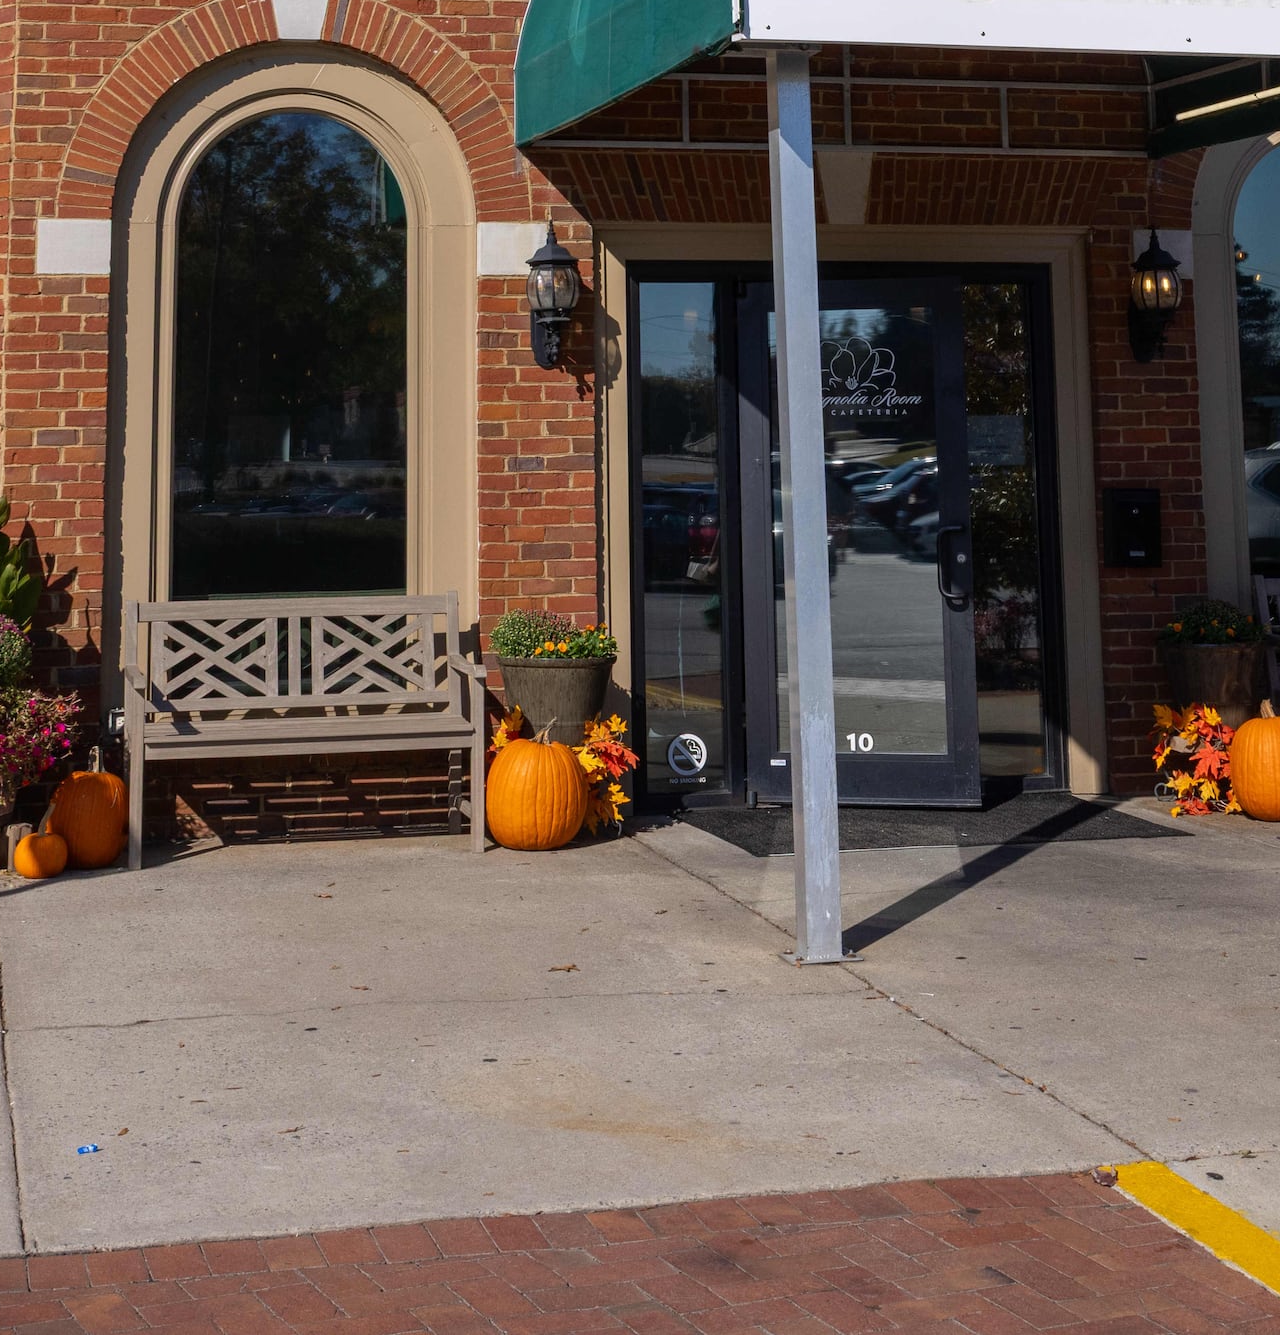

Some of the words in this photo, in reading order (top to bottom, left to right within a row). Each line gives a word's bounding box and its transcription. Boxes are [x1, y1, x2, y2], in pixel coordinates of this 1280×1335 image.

[870, 387, 922, 407] Room
[846, 732, 874, 752] 10
[680, 776, 707, 784] SMOKING
